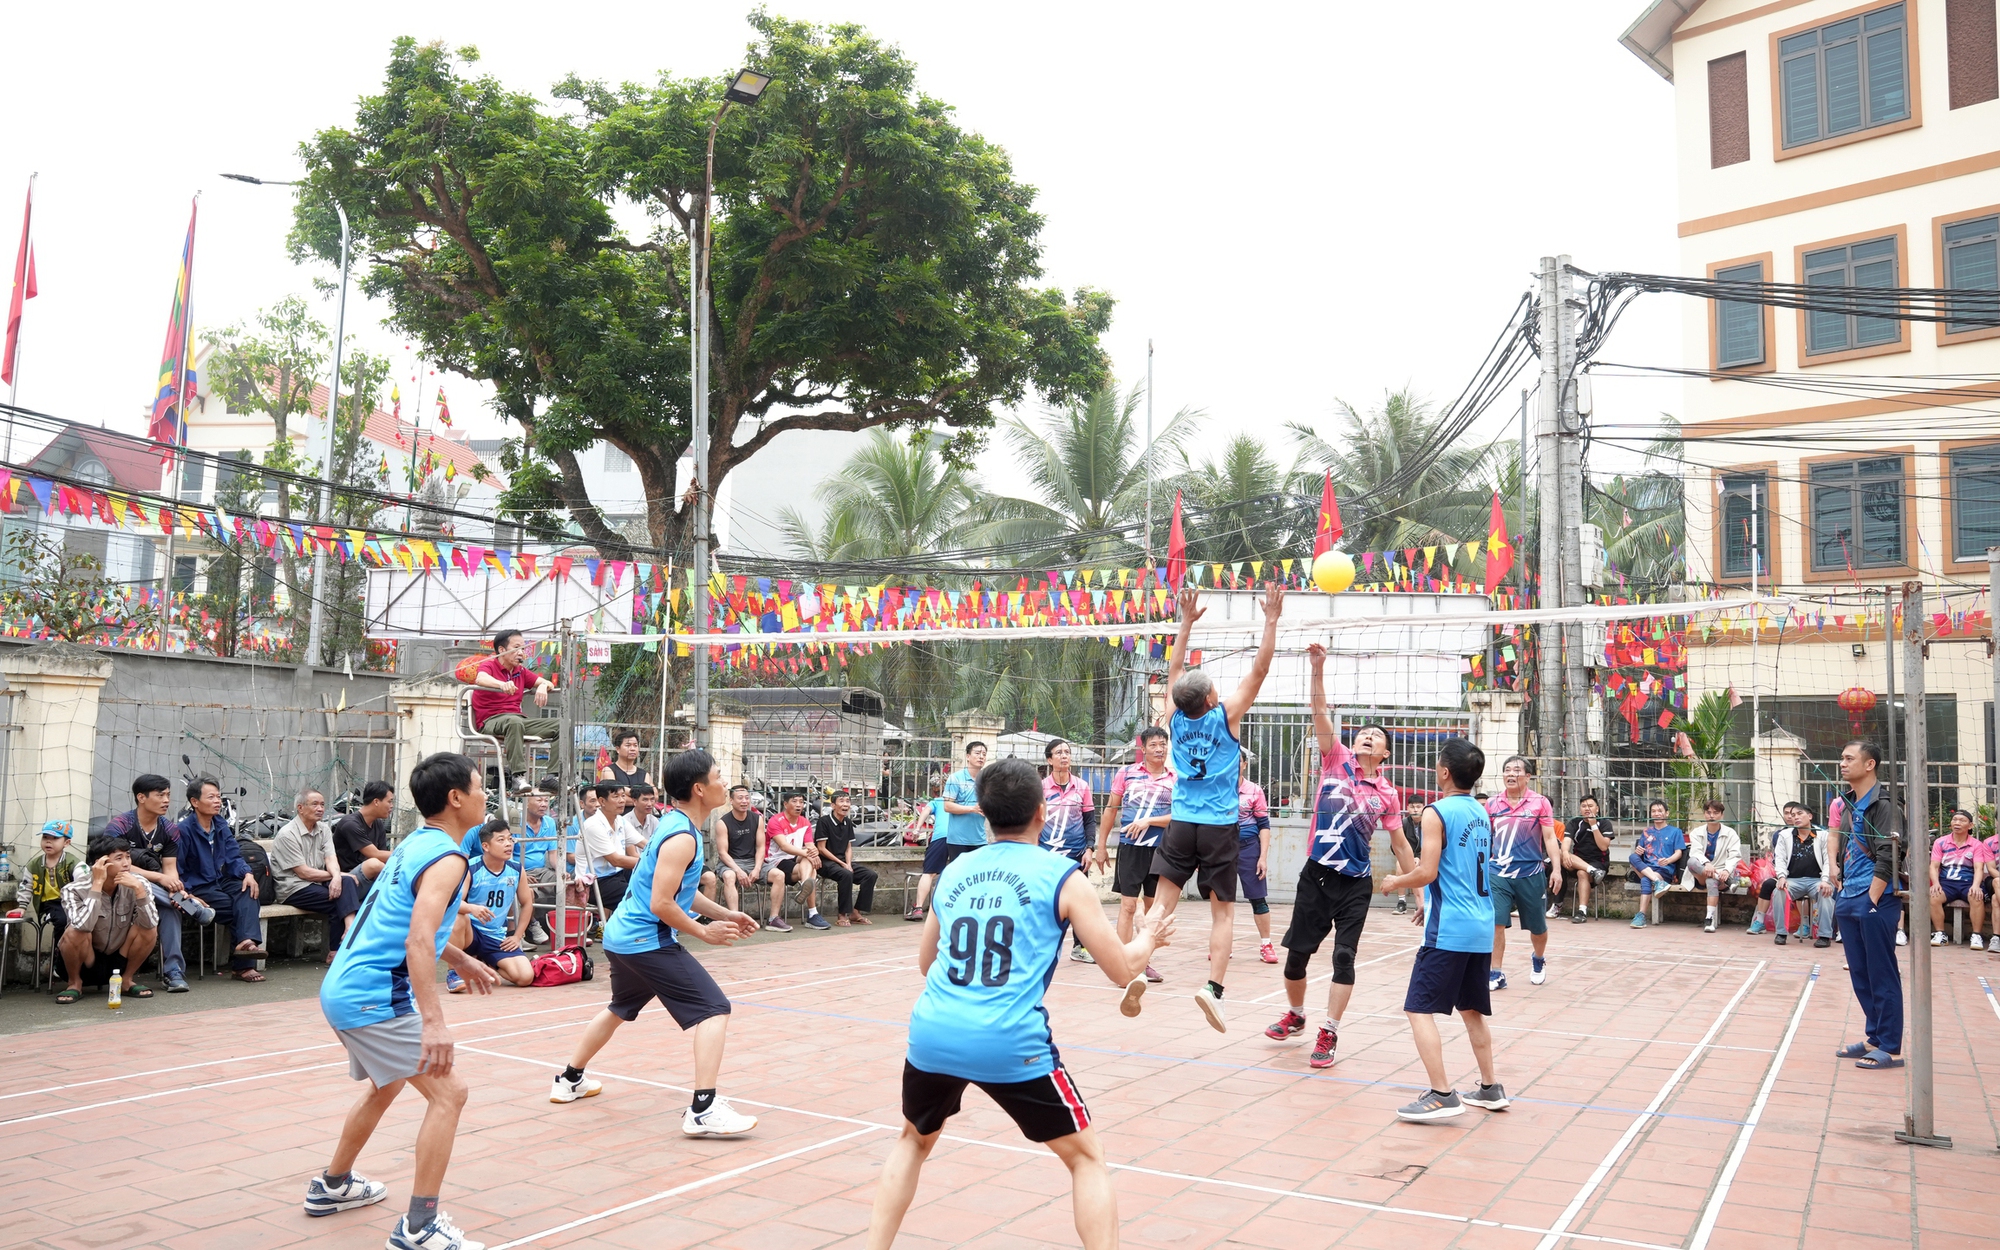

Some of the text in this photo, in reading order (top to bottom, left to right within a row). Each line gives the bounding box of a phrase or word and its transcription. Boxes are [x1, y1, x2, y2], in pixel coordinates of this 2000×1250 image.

[604, 647, 609, 657] 5
[1480, 838, 1488, 848] 16
[486, 889, 505, 908] 88
[945, 882, 966, 909] BÓNG
[1003, 871, 1021, 887] HƠI
[1014, 881, 1032, 907] NAM
[969, 892, 1003, 910] TỔ 16
[947, 915, 1015, 987] 98
